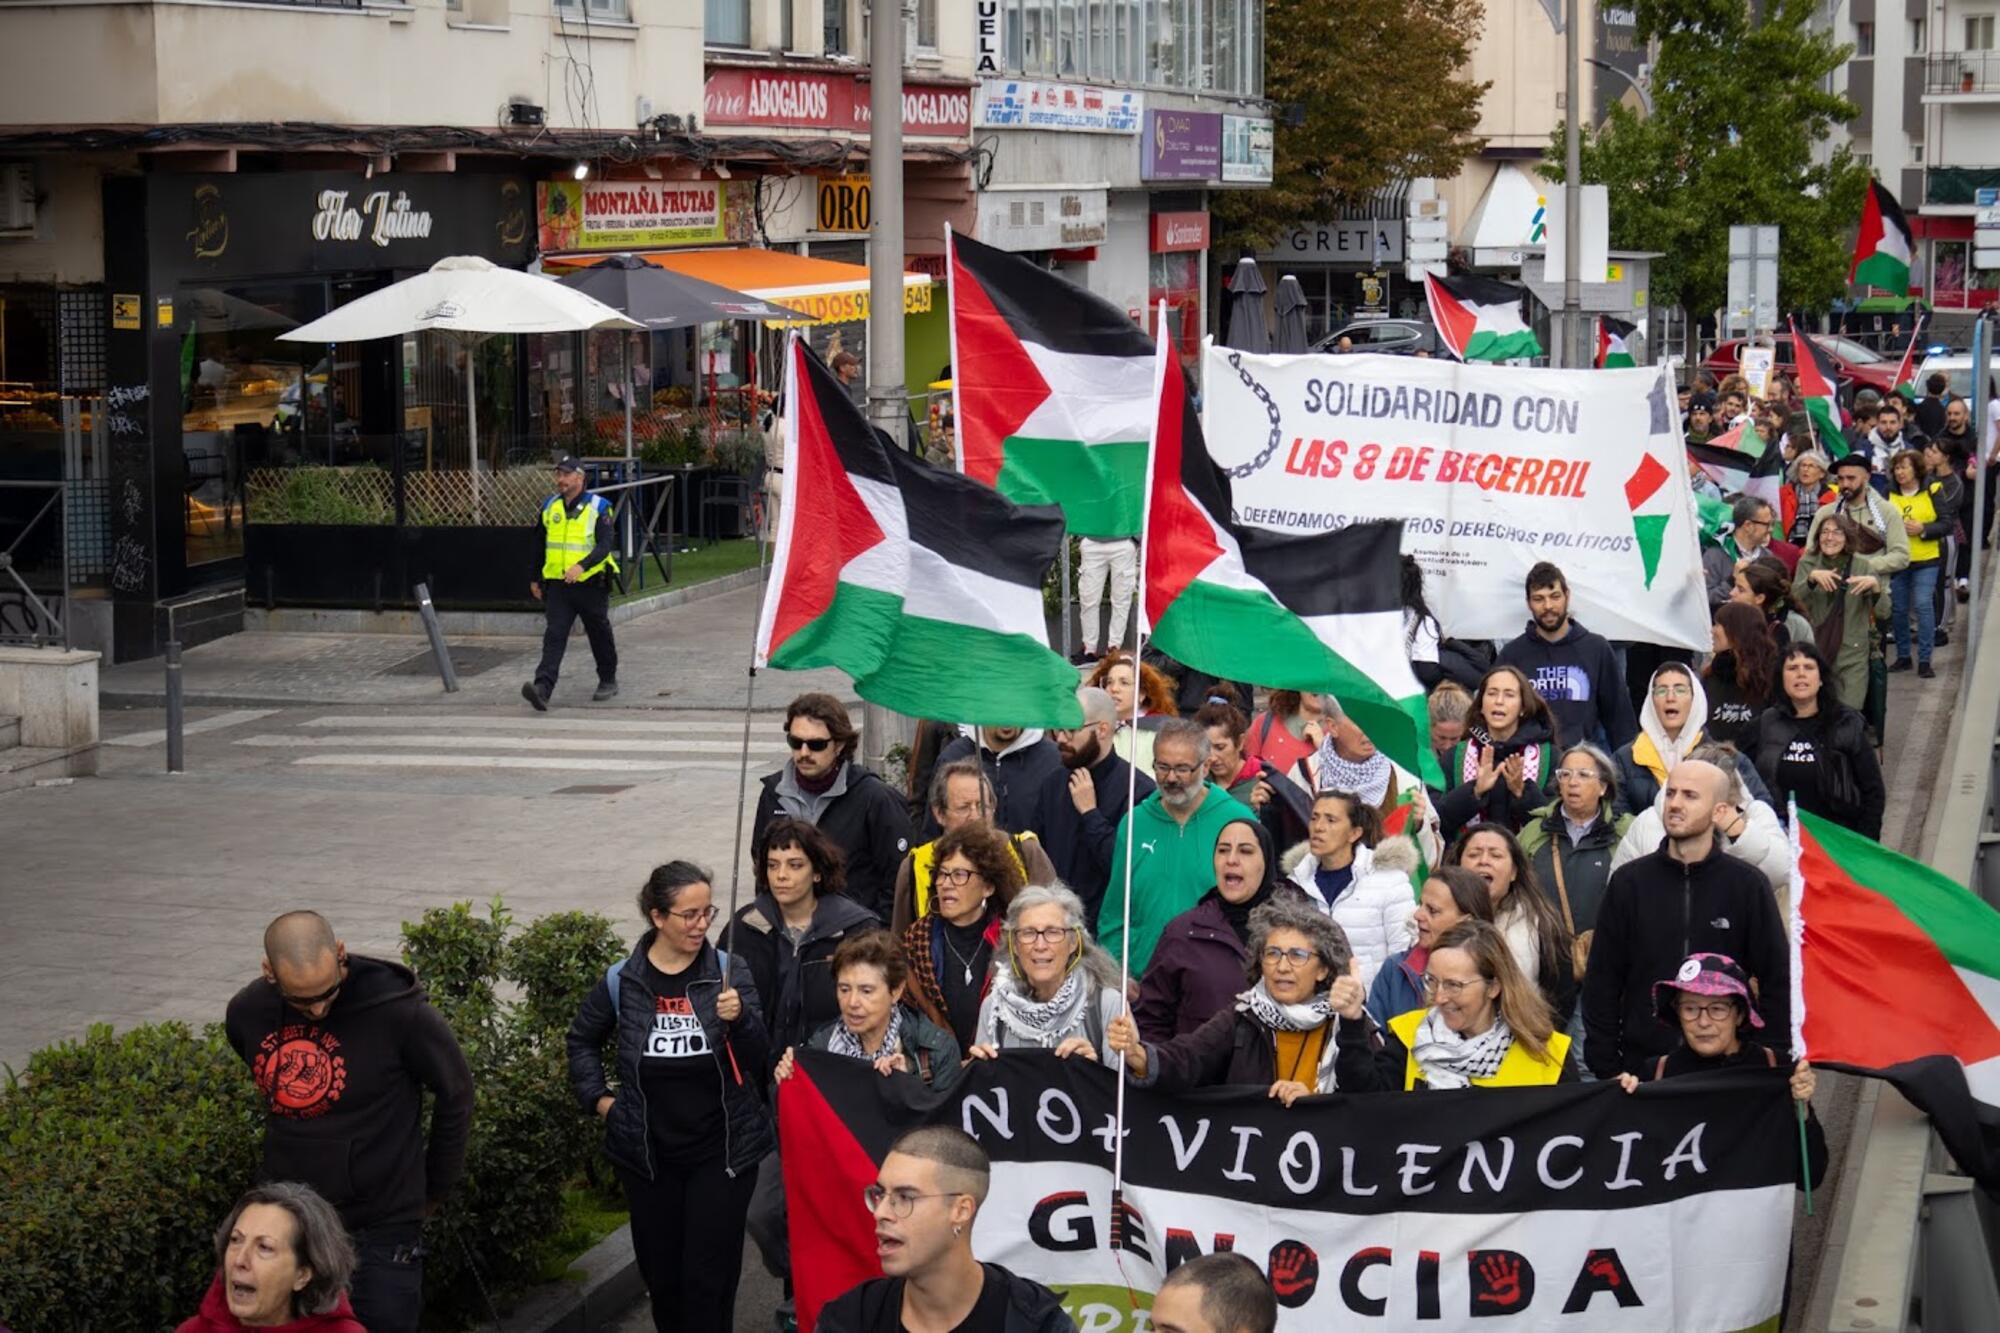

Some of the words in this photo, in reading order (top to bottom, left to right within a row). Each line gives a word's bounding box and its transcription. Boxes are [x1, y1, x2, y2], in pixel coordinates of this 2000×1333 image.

[704, 88, 745, 115] orre
[748, 79, 827, 119] ABOGADOS
[901, 92, 969, 125] BOGADOS
[313, 188, 363, 242] Flor
[364, 190, 433, 248] Latina
[585, 185, 659, 216] MONTAÑA
[661, 190, 715, 213] FRUTAS
[820, 184, 871, 230] ORO
[1173, 222, 1203, 245] Santander
[1291, 230, 1391, 251] GRETA
[1304, 378, 1502, 428] SOLIDARIDAD
[1513, 395, 1579, 435] CON
[1285, 438, 1348, 478] LAS
[1353, 444, 1382, 481] 8
[1385, 446, 1434, 482] DE
[1435, 450, 1591, 498] BECERRIL
[1244, 506, 1347, 531] DEFENDAMOS
[1449, 520, 1539, 545] DERECHOS
[1541, 531, 1634, 553] POLÍTICOS
[1528, 677, 1567, 690] ORTH
[1536, 666, 1567, 680] THE
[1158, 1115, 1710, 1198] VIOLENCIA
